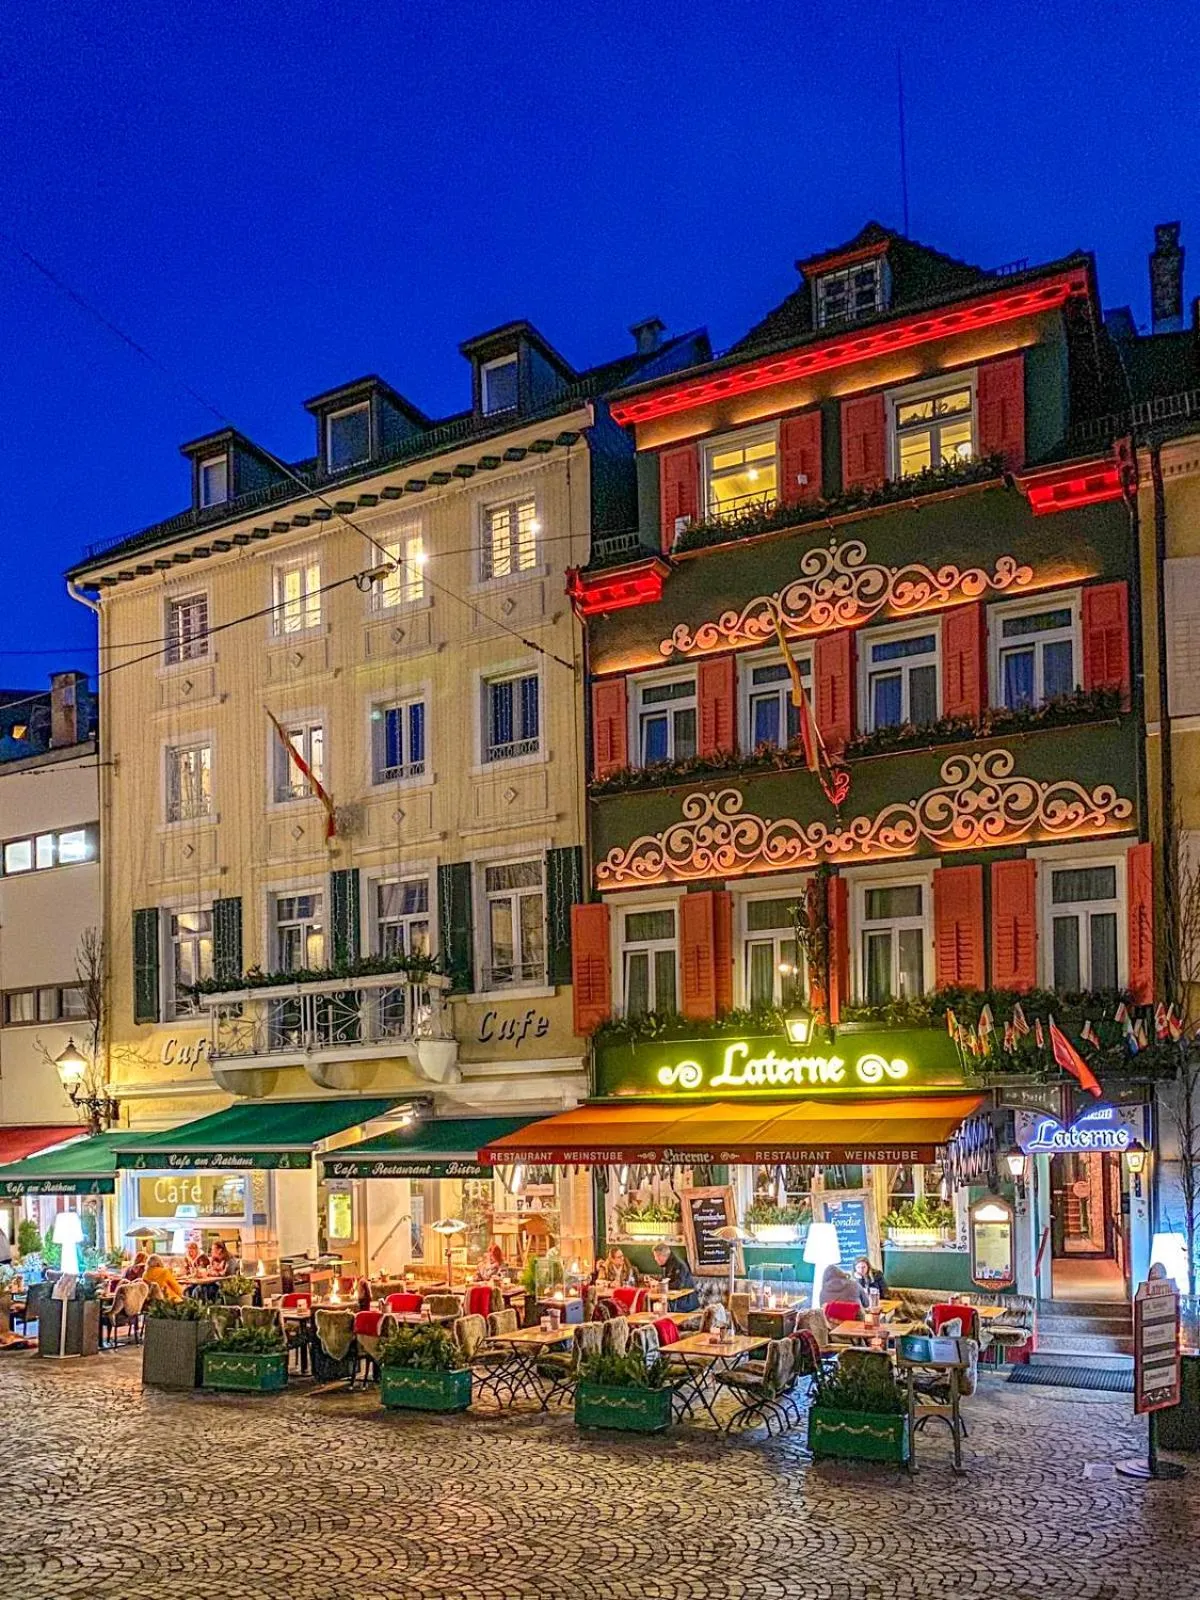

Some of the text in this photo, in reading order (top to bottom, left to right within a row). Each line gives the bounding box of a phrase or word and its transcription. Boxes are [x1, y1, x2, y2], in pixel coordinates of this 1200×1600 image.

[477, 1008, 551, 1049] Cafe
[161, 1037, 212, 1072] Caf
[709, 1041, 846, 1087] Laterne
[1028, 1119, 1130, 1149] Laterne
[168, 1153, 253, 1169] Cafe am Rathaus
[489, 1151, 623, 1161] RESTAURANT WEINSTUBE
[661, 1148, 714, 1164] Laterne
[755, 1150, 919, 1161] RESTAURANT WEINSTUBE
[333, 1162, 359, 1178] Cafe
[371, 1162, 431, 1175] Restaurant
[445, 1161, 481, 1175] Bistro
[5, 1180, 77, 1196] Cafe am Rathaus
